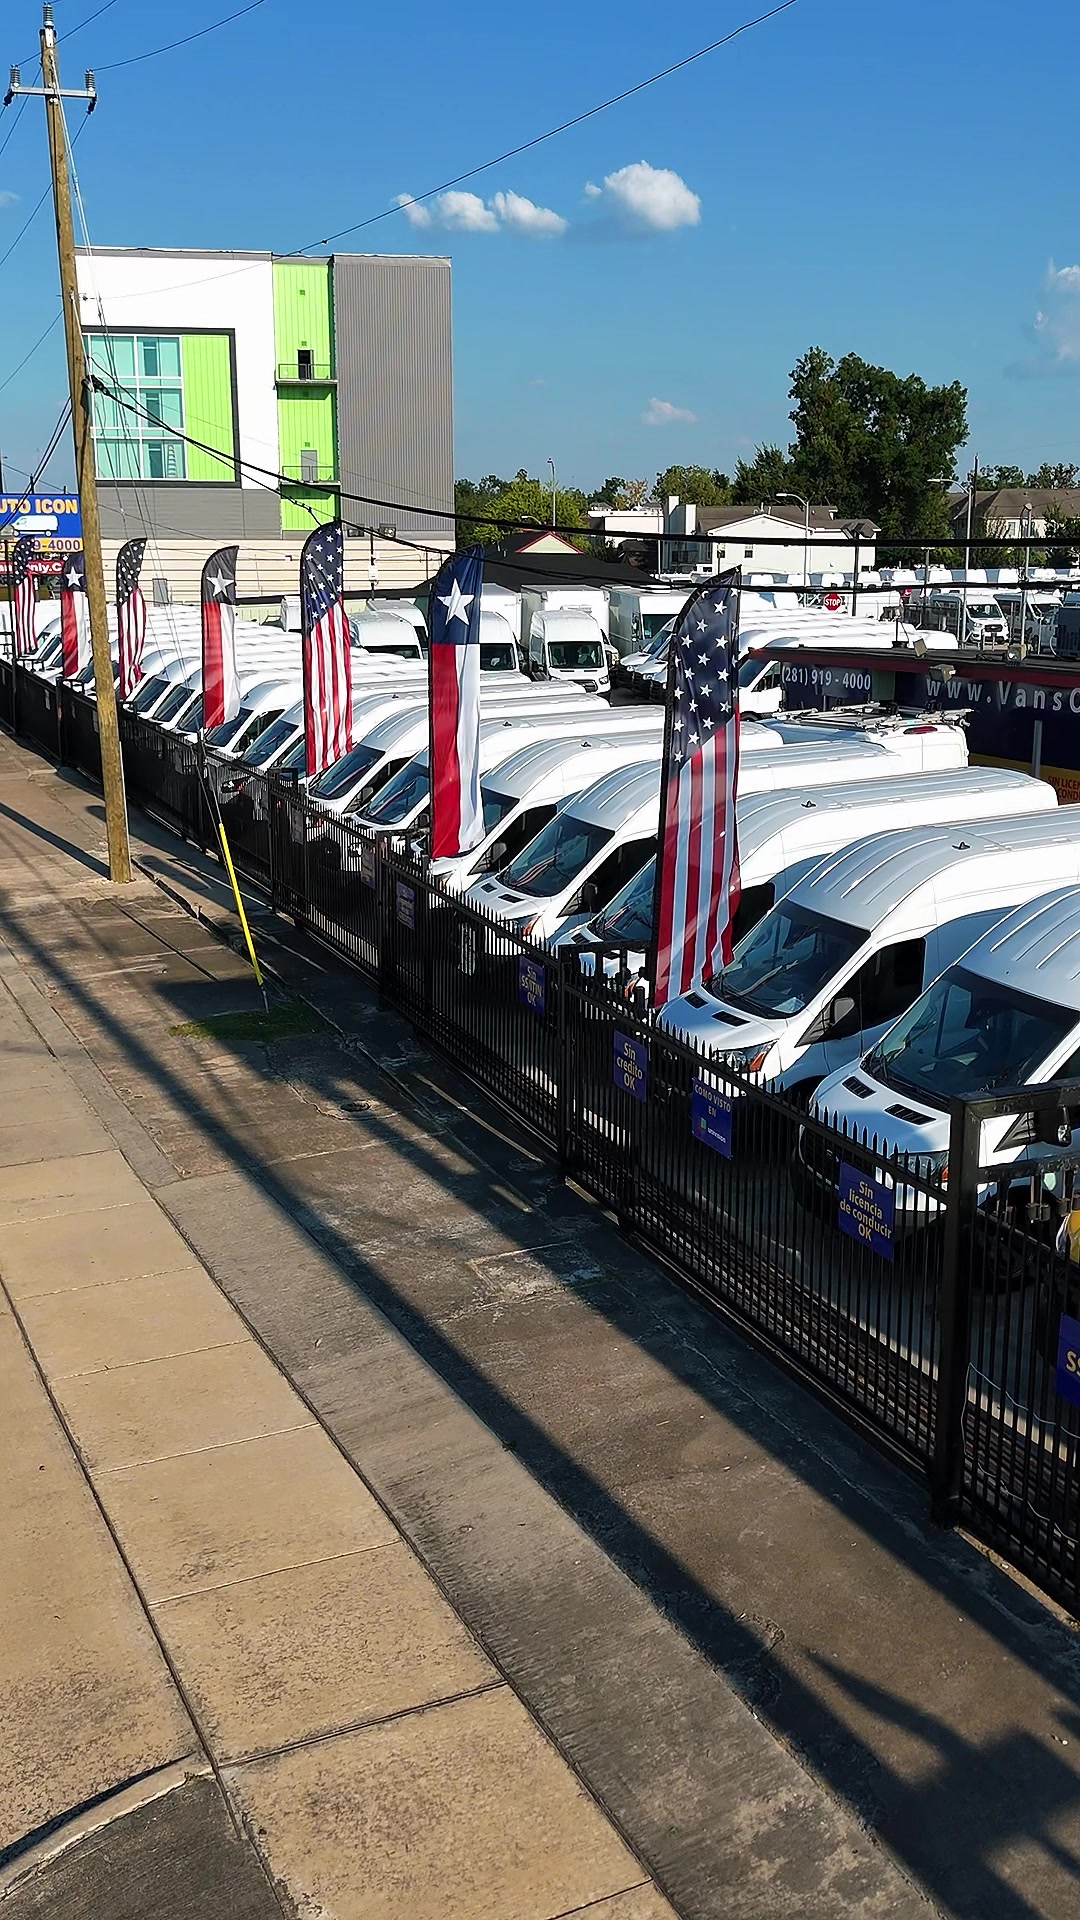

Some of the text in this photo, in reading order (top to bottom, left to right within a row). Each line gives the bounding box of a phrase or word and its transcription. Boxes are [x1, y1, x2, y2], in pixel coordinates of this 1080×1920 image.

[35, 499, 78, 514] ICON
[825, 598, 841, 607] STOP
[782, 665, 808, 686] (281)
[623, 1042, 636, 1061] Sin
[616, 1056, 643, 1080] credito
[623, 1072, 636, 1091] OK
[694, 1084, 731, 1113] COMO VISTO
[708, 1105, 717, 1117] EN
[859, 1180, 873, 1200] Sin
[849, 1188, 882, 1220] licencia
[839, 1198, 892, 1239] de conducir
[858, 1223, 872, 1242] OK
